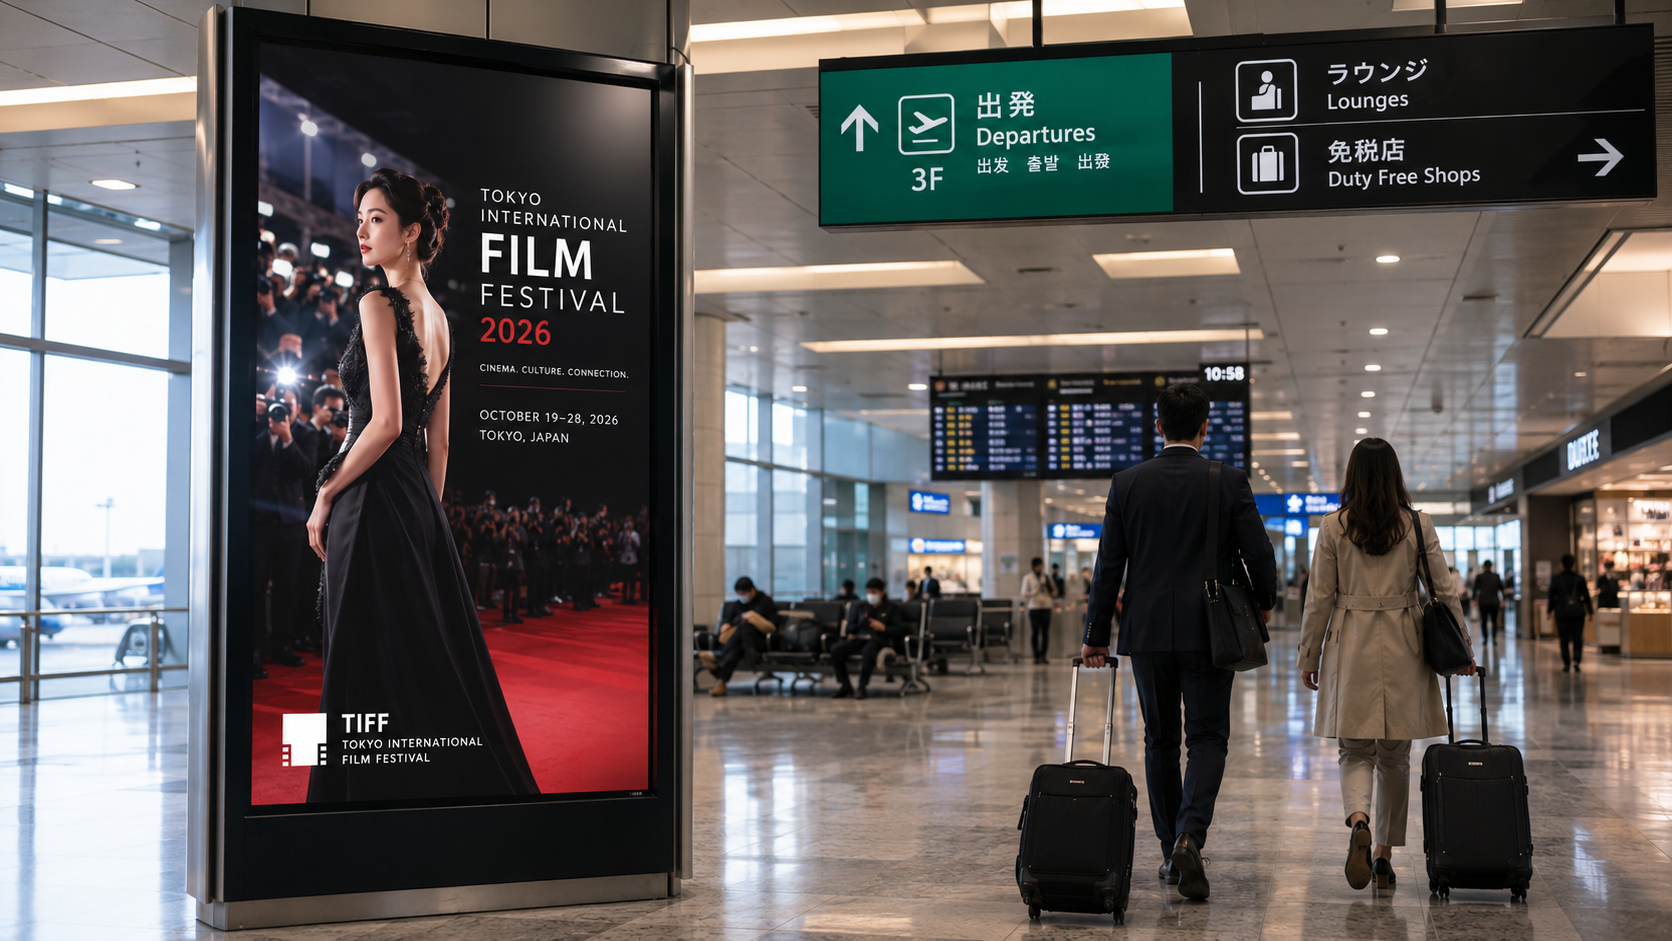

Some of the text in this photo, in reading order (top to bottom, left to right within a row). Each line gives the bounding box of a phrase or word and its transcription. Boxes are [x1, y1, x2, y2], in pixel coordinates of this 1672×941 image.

[1328, 59, 1428, 85] ラウンジ
[978, 91, 1034, 119] 出発
[1328, 94, 1408, 111] Lounges
[977, 126, 1095, 149] Departures
[1328, 138, 1404, 163] 免税店
[978, 157, 1008, 173] 出发
[1027, 155, 1059, 172] 출발
[912, 167, 943, 191] 3F
[1329, 167, 1480, 190] Duty Free Shops
[481, 189, 540, 205] TOKYO
[482, 209, 626, 232] INTERNATIONAL
[482, 233, 591, 279] FILM
[482, 284, 624, 313] FESTIVAL
[481, 317, 550, 345] 2026
[480, 364, 628, 378] CINEMA. CULTURE. CONNECTION.
[1205, 366, 1244, 381] 10:58
[480, 410, 539, 422] OCTOBER
[590, 414, 618, 425] 2026
[480, 430, 568, 443] TOKYO, JAPAN
[342, 713, 389, 733] TIFF
[342, 737, 482, 749] TOKYO INTERNATIONAL
[343, 753, 430, 764] FILM FESTIVAL
